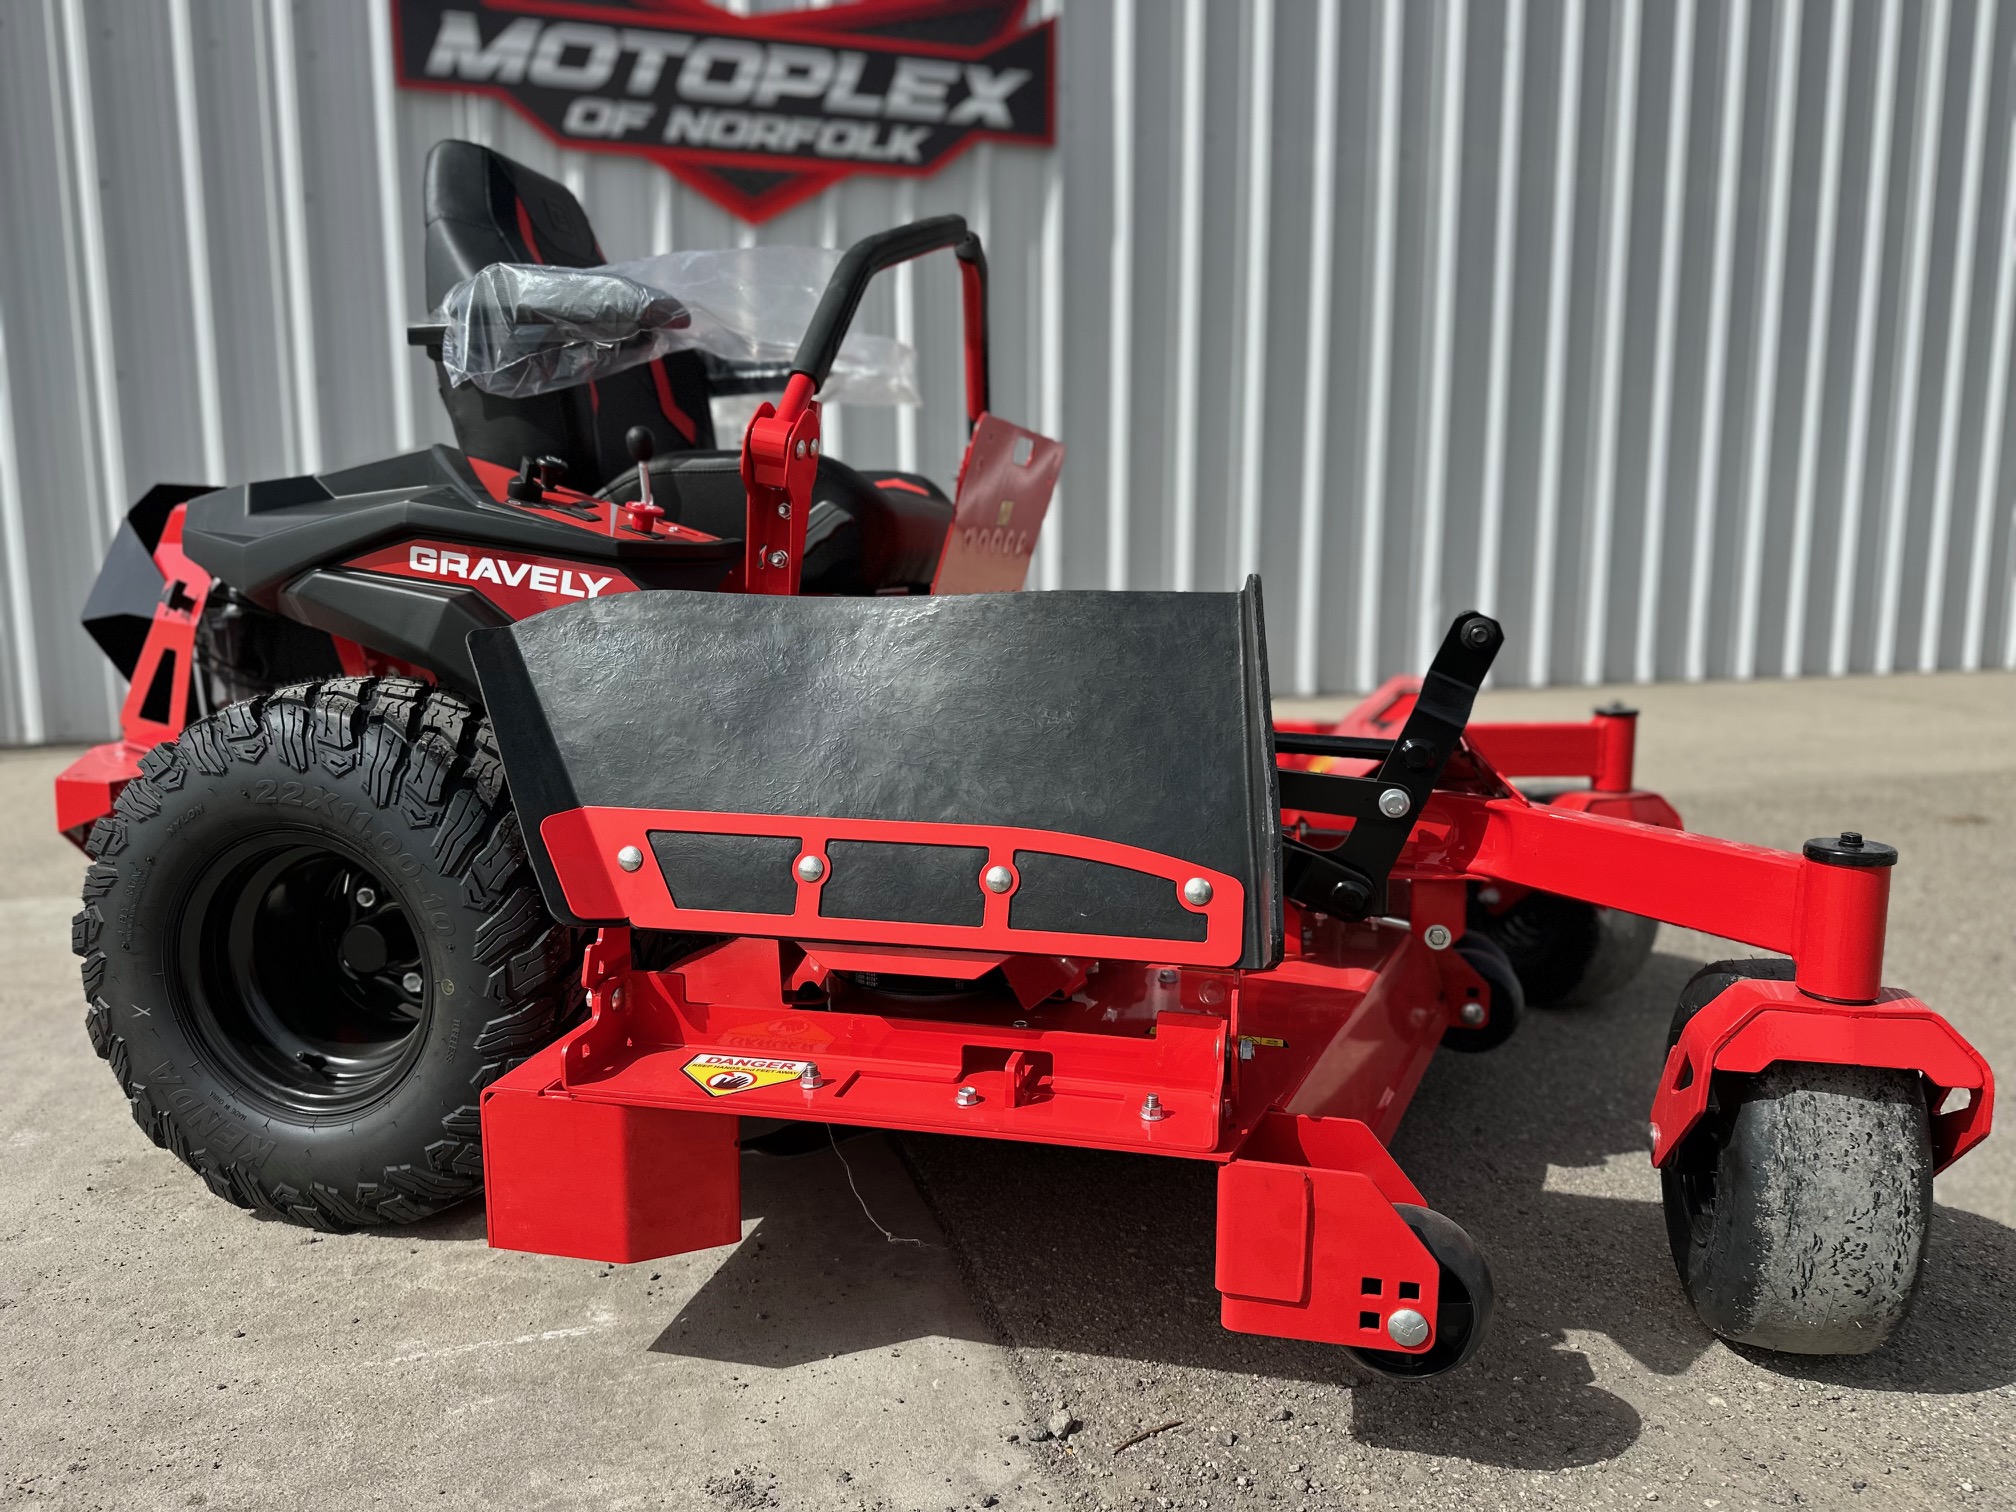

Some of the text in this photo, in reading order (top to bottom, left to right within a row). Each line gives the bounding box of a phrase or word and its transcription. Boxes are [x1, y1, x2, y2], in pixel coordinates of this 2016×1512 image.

[424, 8, 1032, 129] MOTOPLEX
[561, 97, 934, 163] OF NORFOLK
[409, 545, 614, 599] GRAVELY
[166, 803, 205, 838] NYLON
[255, 778, 456, 938] 22X11.00-10
[705, 1056, 797, 1071] DANGER
[148, 1060, 276, 1169] KENDA
